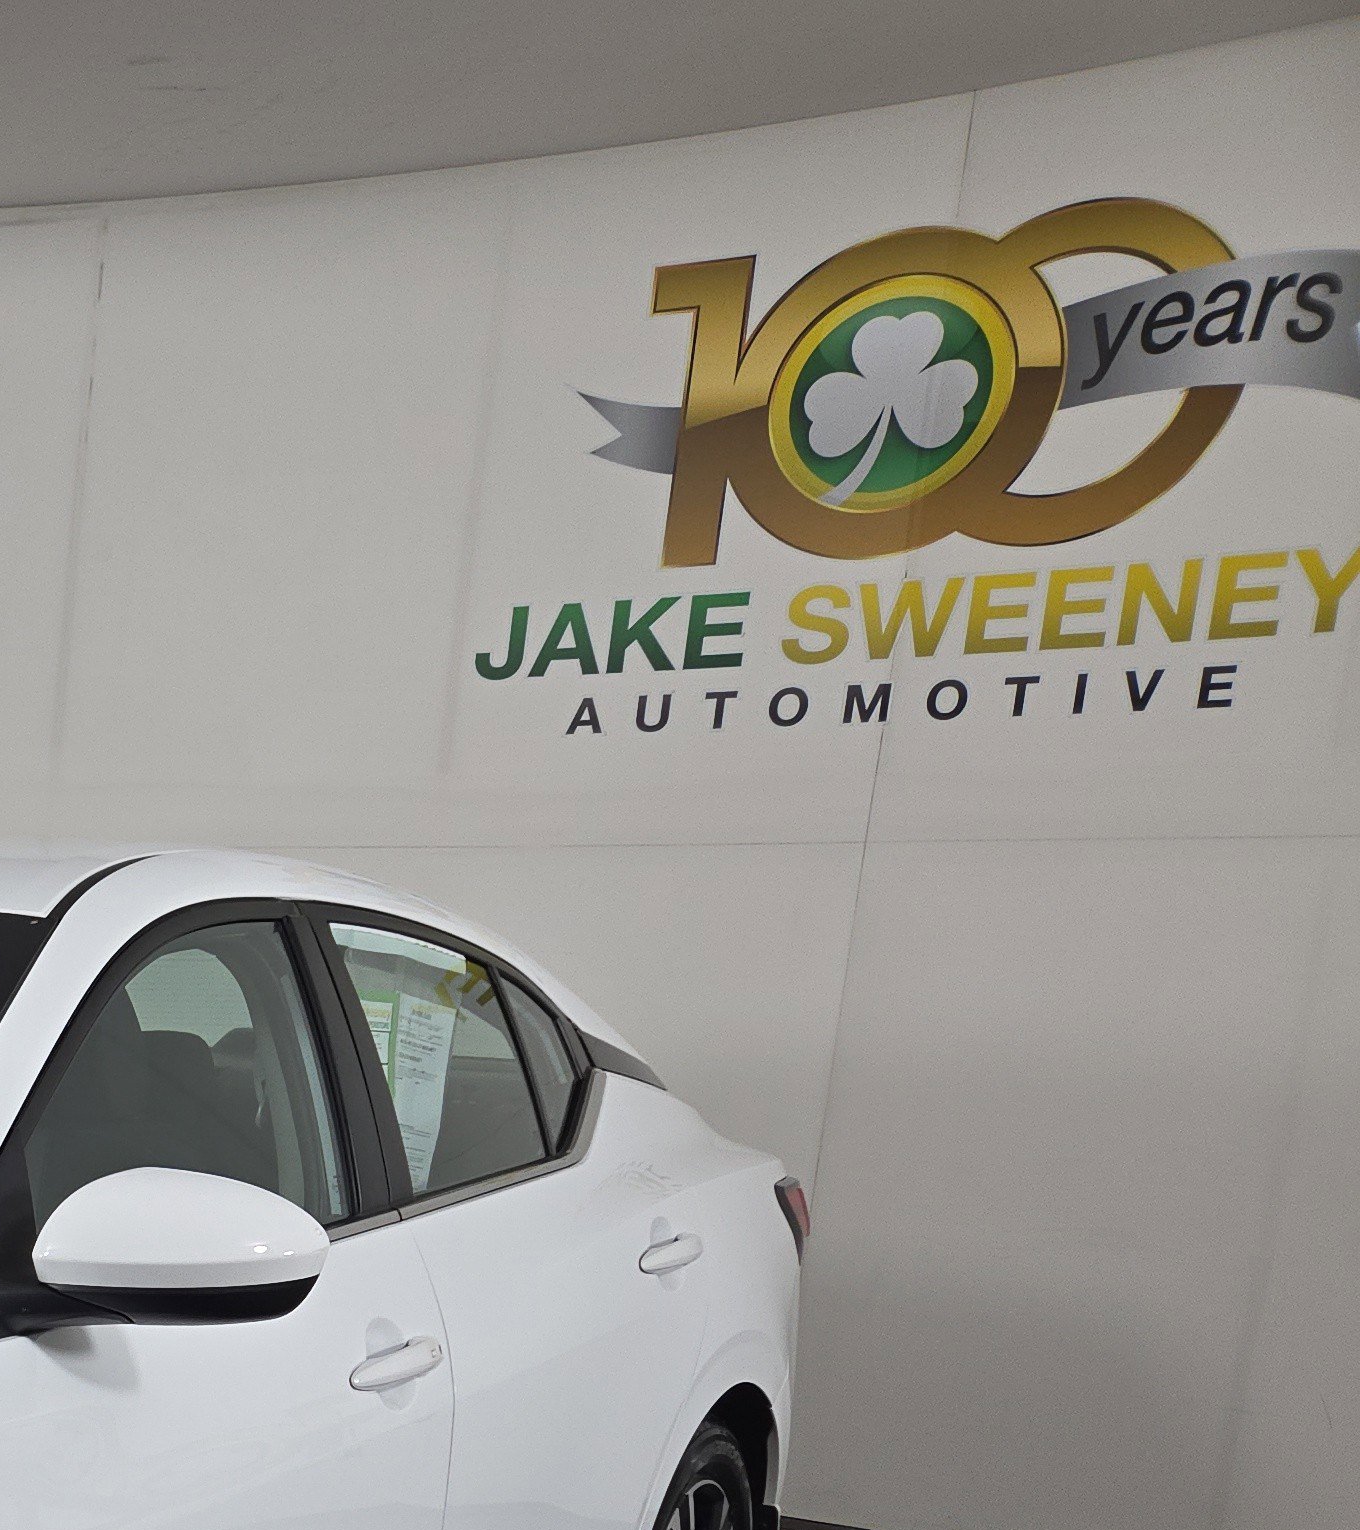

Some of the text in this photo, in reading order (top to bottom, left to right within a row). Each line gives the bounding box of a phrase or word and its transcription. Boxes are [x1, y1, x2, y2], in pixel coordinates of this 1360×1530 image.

[651, 196, 1343, 568] 100 years
[475, 545, 1360, 680] JAKE SWEENEY
[565, 664, 1238, 735] AUTOMOTIVE
